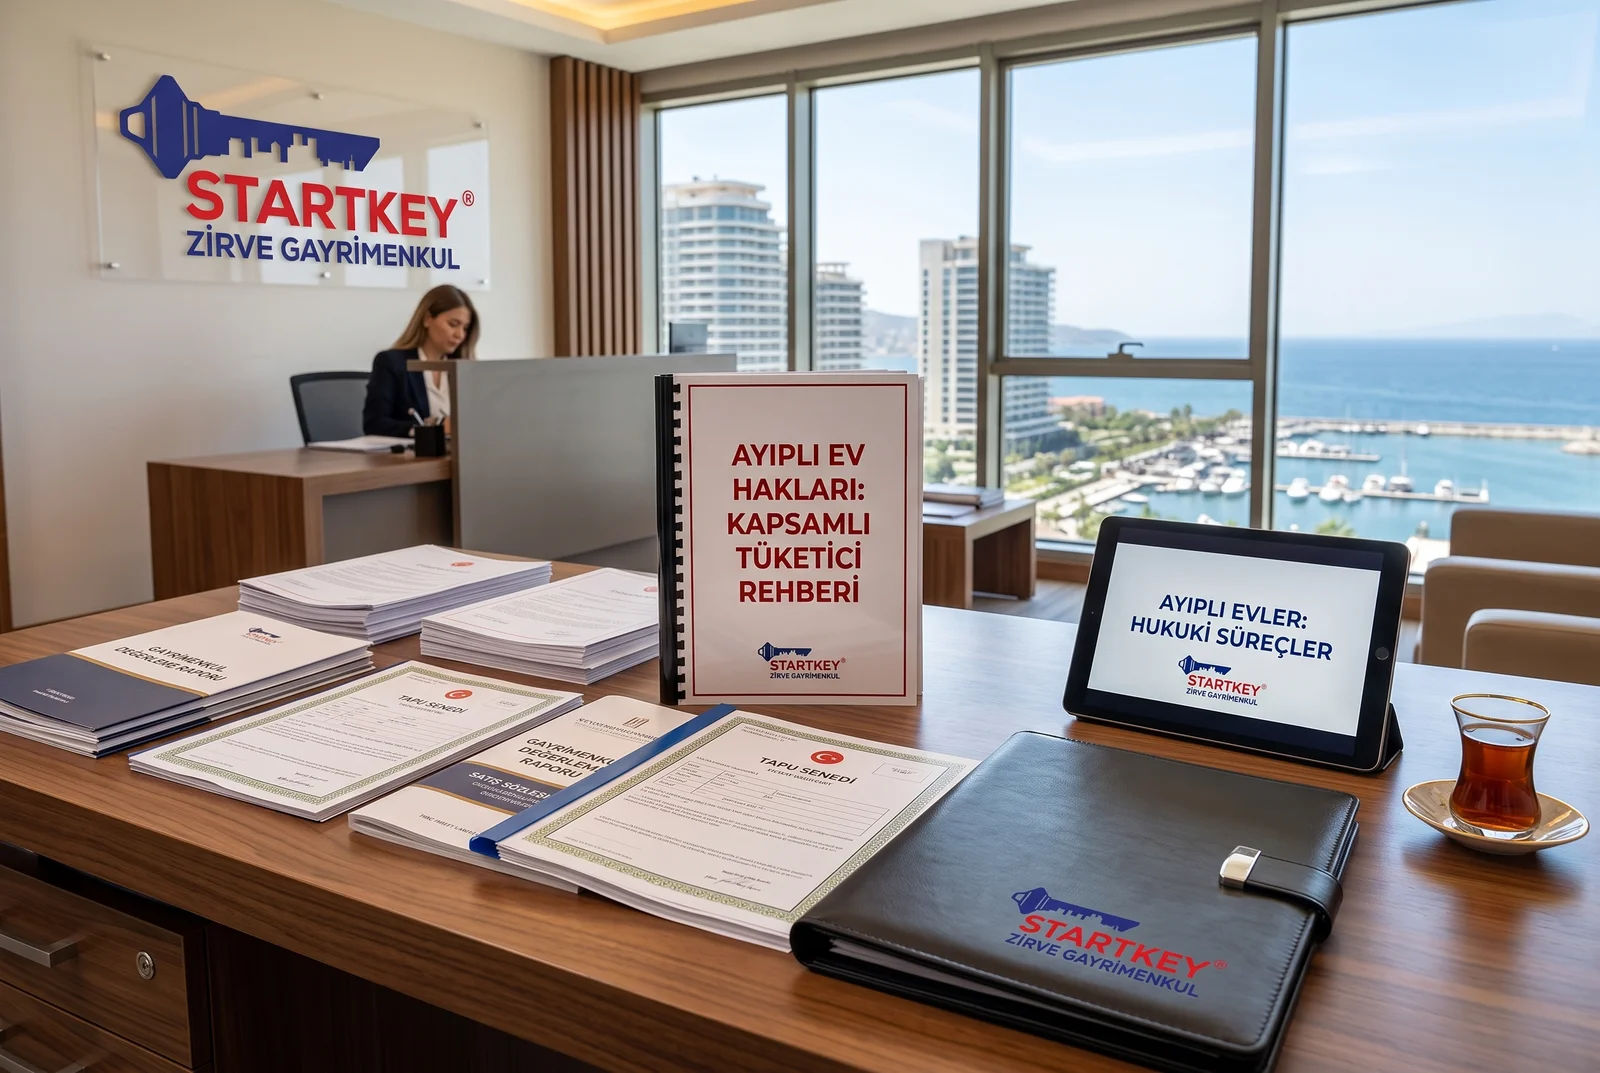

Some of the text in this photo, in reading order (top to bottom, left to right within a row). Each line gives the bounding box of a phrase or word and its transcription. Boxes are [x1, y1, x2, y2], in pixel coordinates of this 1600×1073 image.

[186, 224, 461, 270] ZİRVE GAYRİMENKUL
[732, 443, 866, 466] AYIPLI EV
[733, 478, 865, 501] HAKLARI:
[727, 512, 871, 535] KAPSAMLI
[735, 540, 862, 569] TÜKETİCİ
[739, 574, 860, 603] REHBERİ
[1159, 594, 1308, 630] AYIPLI EVLER:
[1130, 615, 1333, 661] HUKUKİ SÜREÇLER
[1186, 686, 1258, 706] ZİRVE GAYRİMENKUL
[518, 746, 601, 773] DEĞERLEM
[519, 757, 582, 778] RAPORU
[760, 756, 799, 771] TAPU
[799, 767, 858, 784] SENEDİ
[1004, 933, 1199, 998] ZİRVE GAYRİMENKUL
